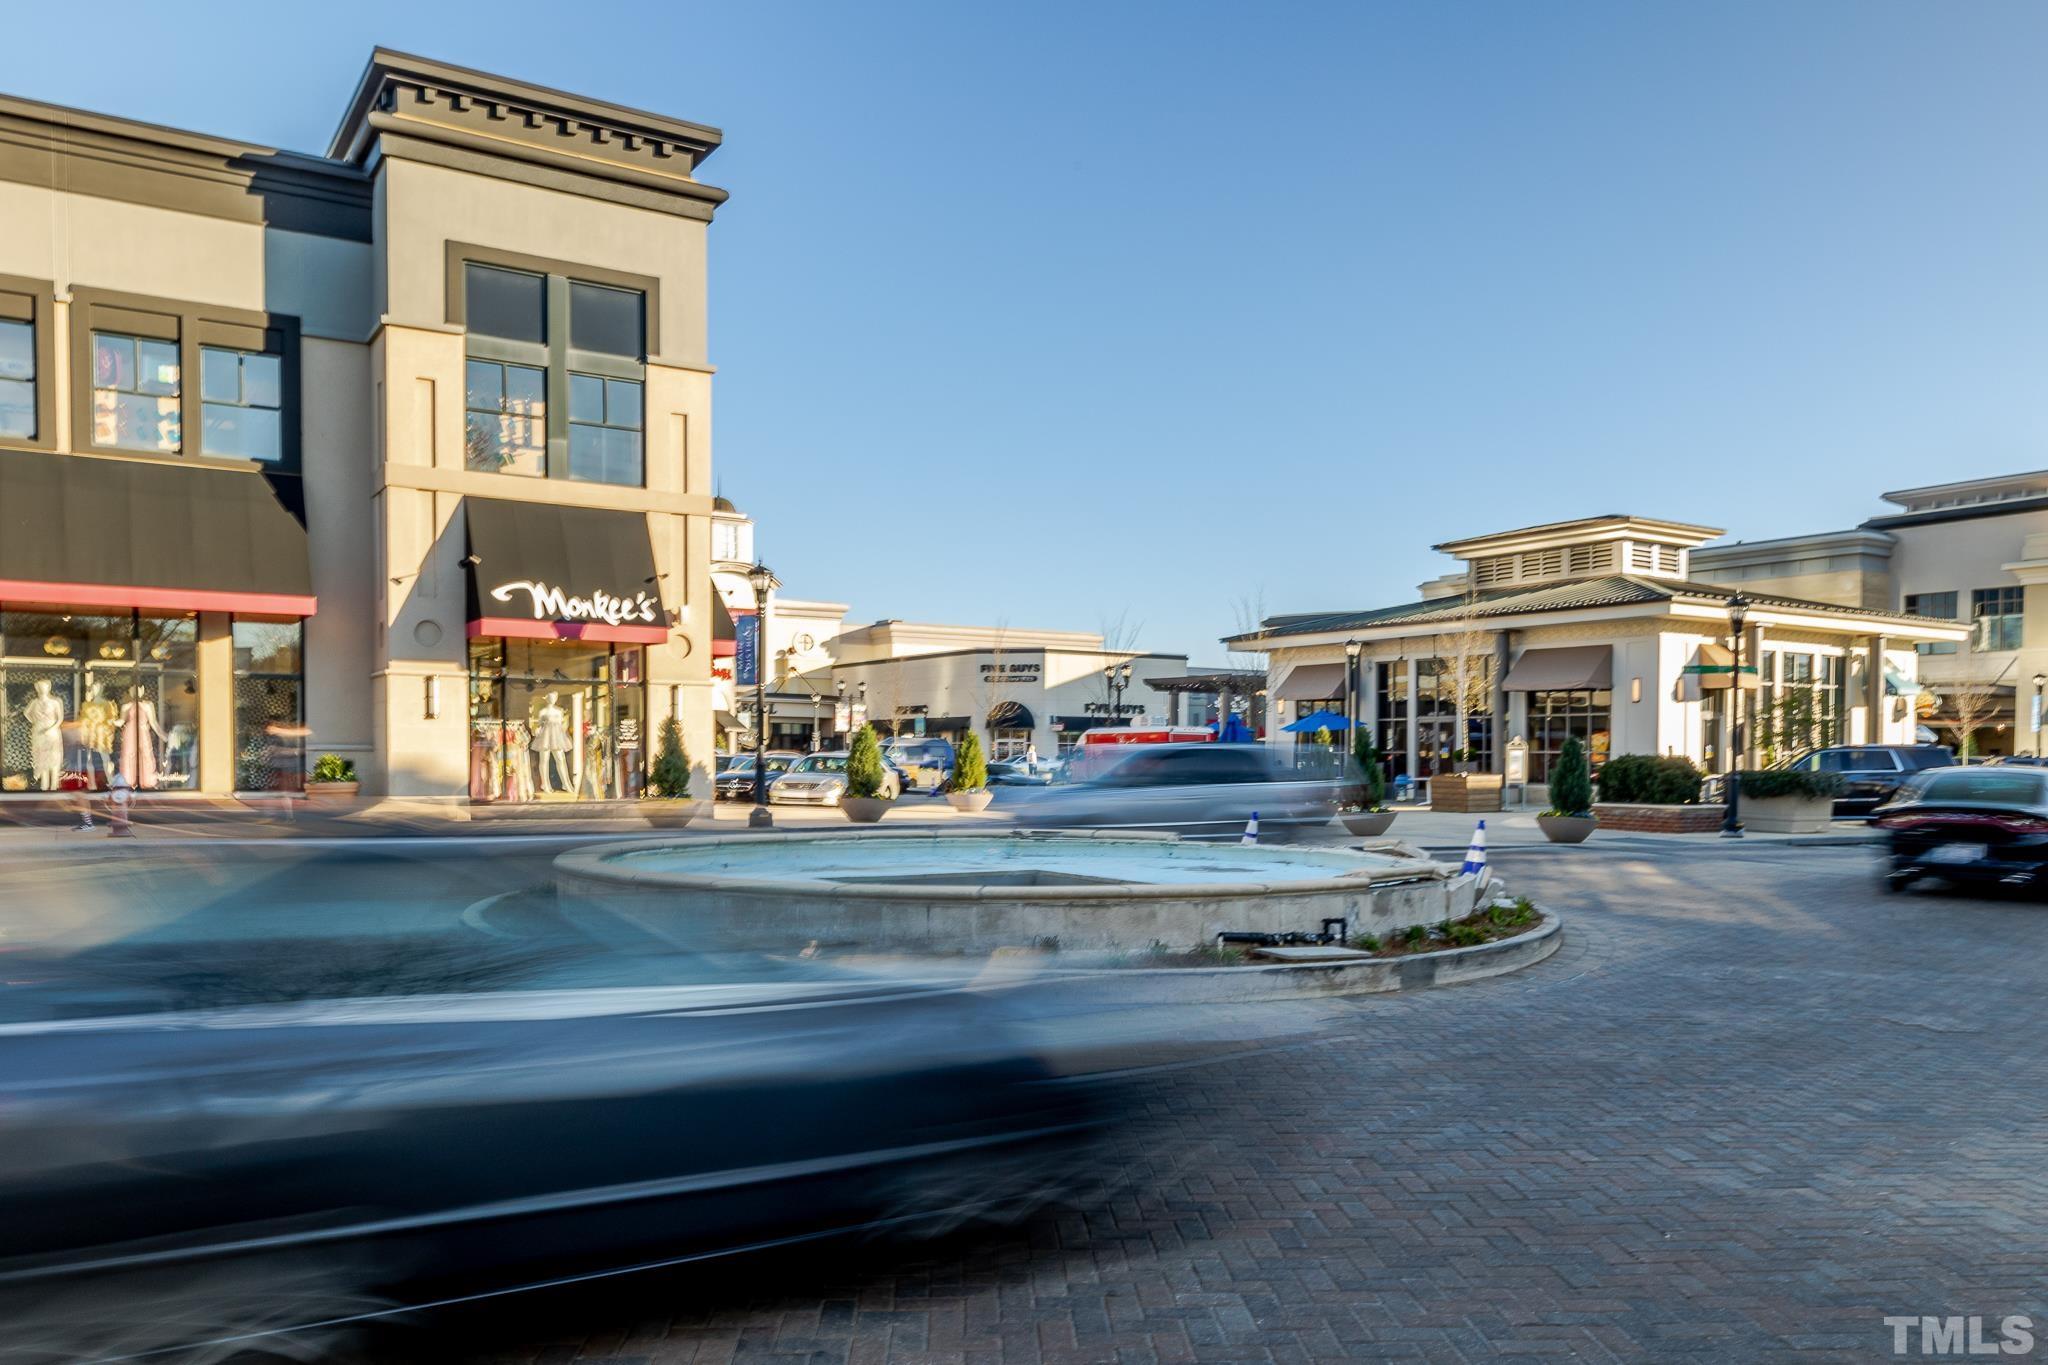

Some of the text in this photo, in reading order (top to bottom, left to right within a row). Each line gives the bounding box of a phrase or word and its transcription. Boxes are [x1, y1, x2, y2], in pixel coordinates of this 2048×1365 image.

[490, 580, 657, 627] Monkee's
[1009, 663, 1041, 673] GUYS
[1084, 703, 1111, 714] FVE
